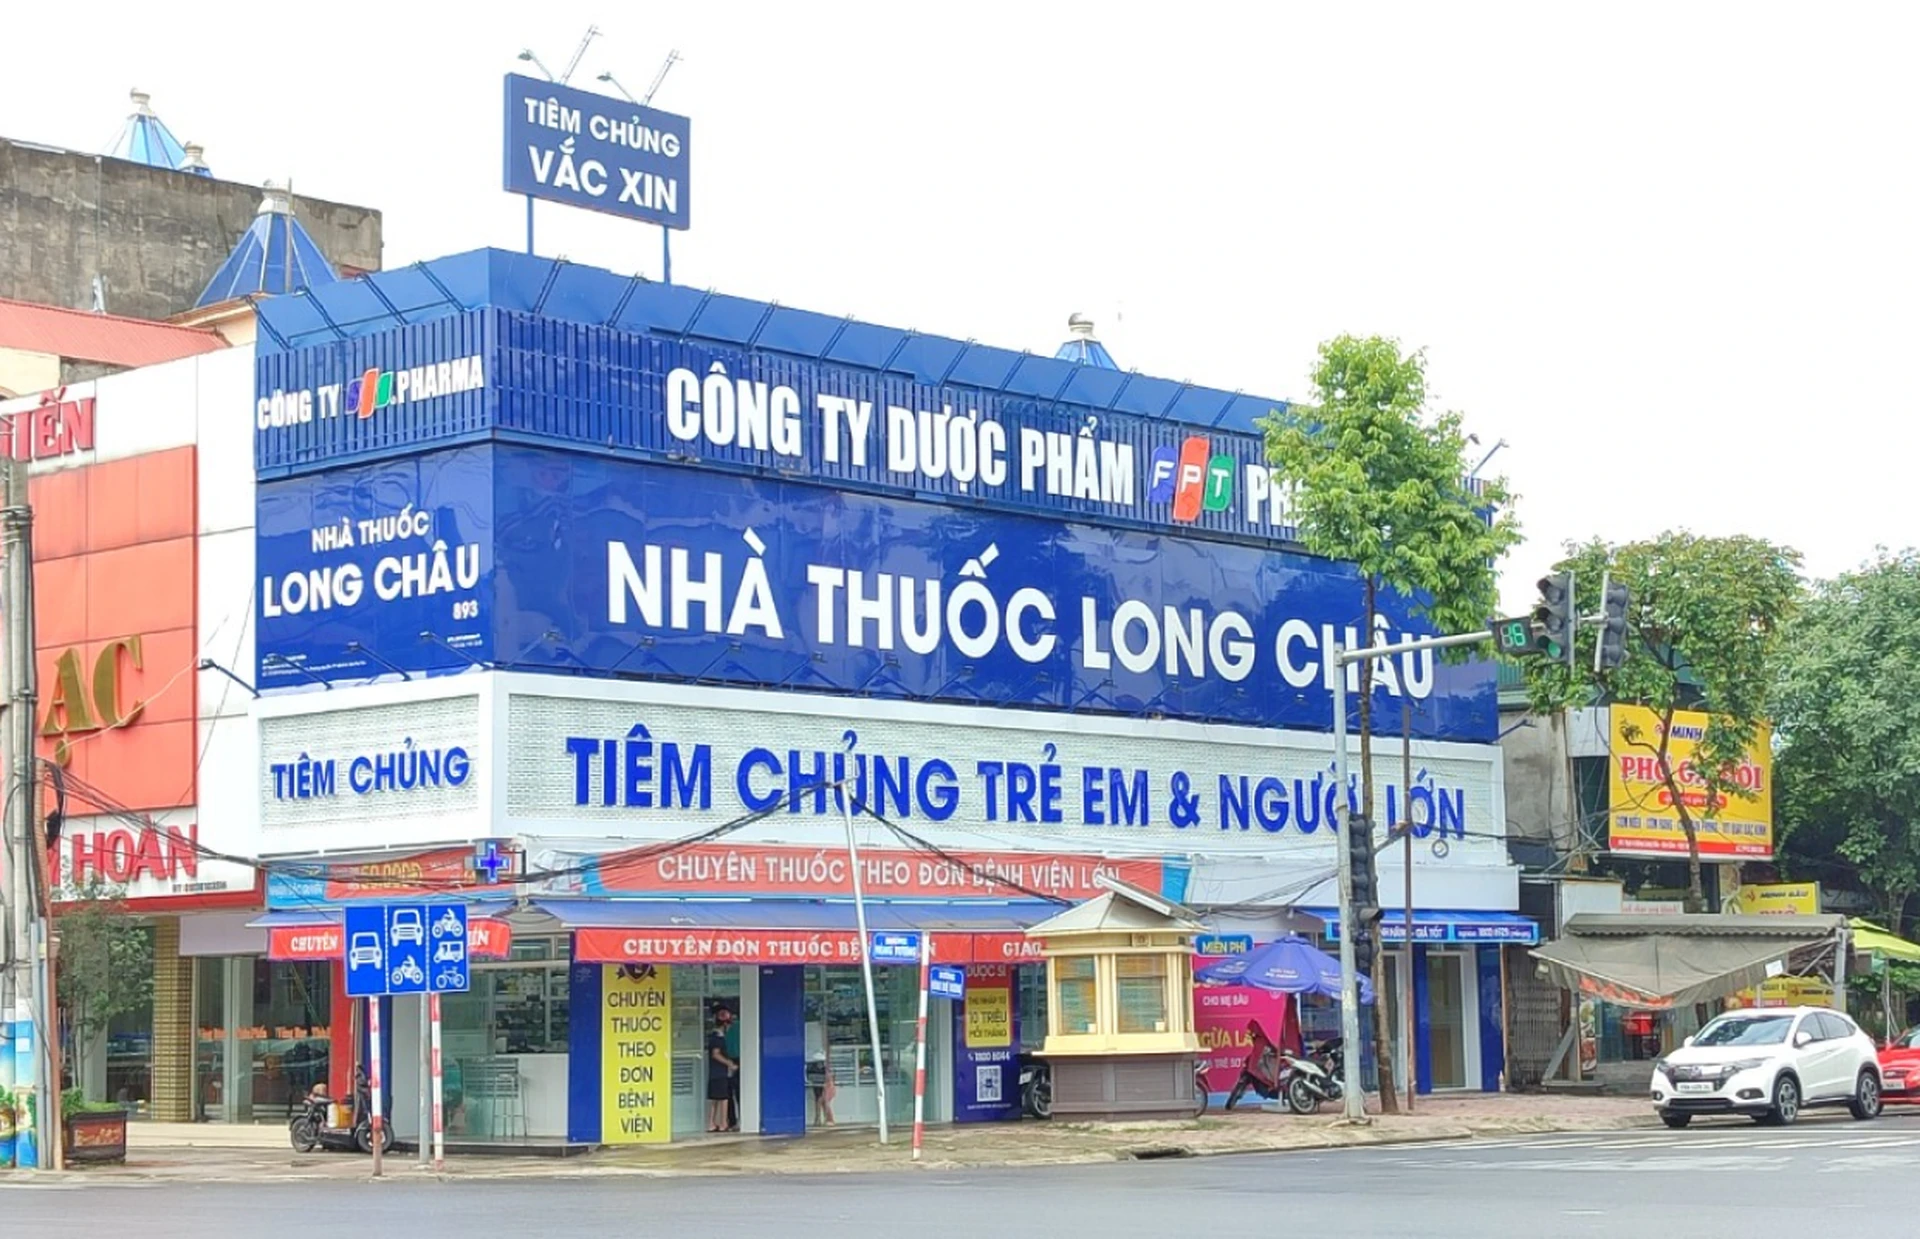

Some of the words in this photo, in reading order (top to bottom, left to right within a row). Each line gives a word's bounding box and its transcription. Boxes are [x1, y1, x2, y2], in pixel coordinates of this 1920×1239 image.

[524, 97, 581, 134] TIÊM
[589, 115, 681, 158] CHỦNG
[528, 136, 608, 197] VẮC
[618, 167, 677, 214] XIN
[257, 389, 312, 430] CÔNG
[318, 384, 342, 419] TY
[667, 361, 802, 457] CÔNG
[817, 393, 872, 466] TY
[888, 404, 1007, 493] DƯỢC
[1020, 416, 1134, 506] PHẨM
[312, 516, 354, 552] NHÀ
[358, 503, 430, 545] THUỐC
[263, 563, 364, 618] LONG
[374, 539, 480, 601] CHÂU
[452, 600, 479, 620] 893
[607, 526, 784, 640] NHÀ
[807, 542, 1057, 663] THUỐC
[1081, 597, 1256, 682] LONG
[1275, 613, 1434, 699] CHÂU
[1671, 725, 1703, 740] MINH
[270, 752, 336, 800] TIÊM
[349, 737, 470, 795] CHỦNG
[566, 723, 712, 810] TIÊM
[736, 729, 960, 821] CHỦNG
[977, 742, 1062, 823] TRẺ
[1082, 766, 1150, 827] EM
[1168, 770, 1201, 828] &
[657, 851, 756, 882] CHUYÊN
[764, 849, 845, 884] THUỐC
[918, 861, 965, 888] ĐƠN
[972, 857, 1023, 894] BỆNH
[1031, 860, 1075, 895] VIỆN
[290, 930, 338, 951] CHUYÊN
[623, 933, 714, 957] CHUYÊN
[716, 934, 760, 957] ĐƠN
[766, 933, 833, 957] THUỐC
[607, 987, 665, 1008] CHUYÊN
[611, 1009, 662, 1033] THUỐC
[618, 1042, 656, 1058] THEO
[620, 1066, 653, 1083] ĐƠN
[618, 1088, 655, 1113] BỆNH
[621, 1113, 653, 1139] VIỆN
